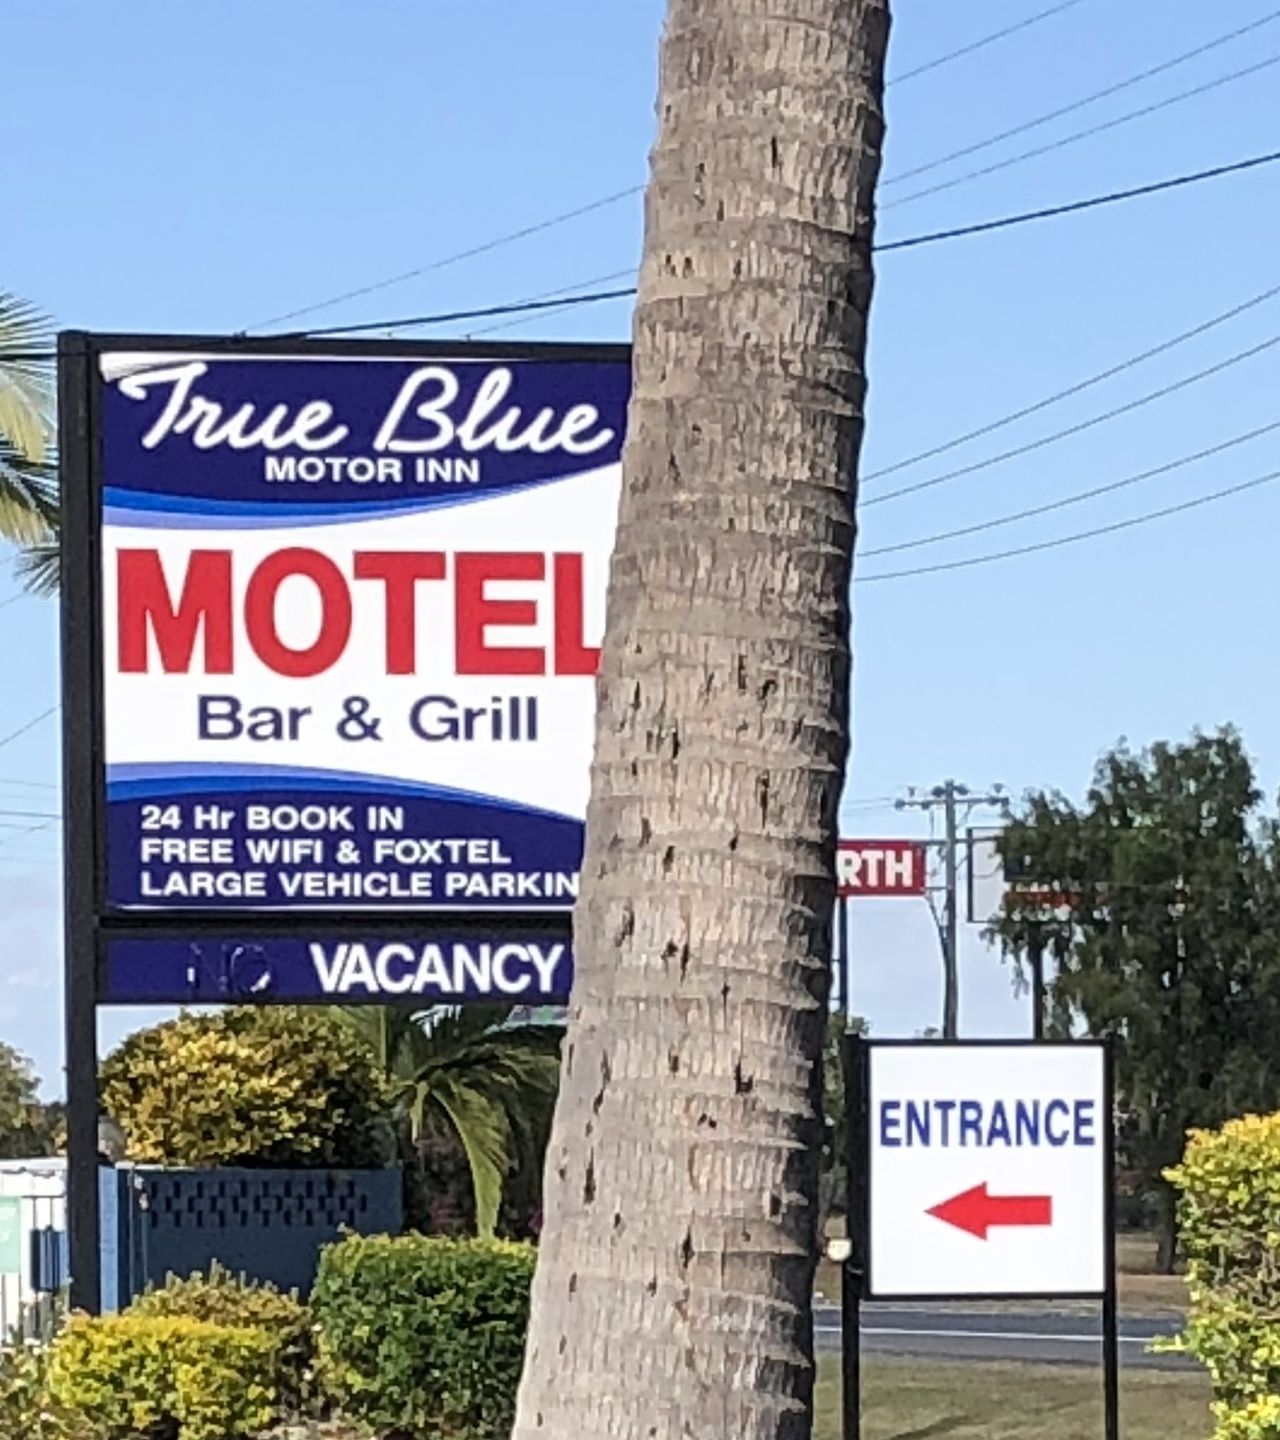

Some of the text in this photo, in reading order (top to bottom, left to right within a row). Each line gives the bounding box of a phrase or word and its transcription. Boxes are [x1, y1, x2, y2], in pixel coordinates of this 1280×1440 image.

[118, 362, 613, 454] True Blue
[265, 456, 479, 483] MOTOR INN
[116, 546, 603, 678] MOTEL
[197, 695, 538, 742] Bar & Grill
[141, 805, 403, 831] 24 Hr BOOK IN
[141, 838, 512, 865] FREE WIFI & FOXTEL
[141, 871, 267, 897] LARGE
[278, 871, 433, 897] VEHICLE
[308, 943, 565, 993] VACANCY
[880, 1099, 1096, 1147] ENTRANCE
